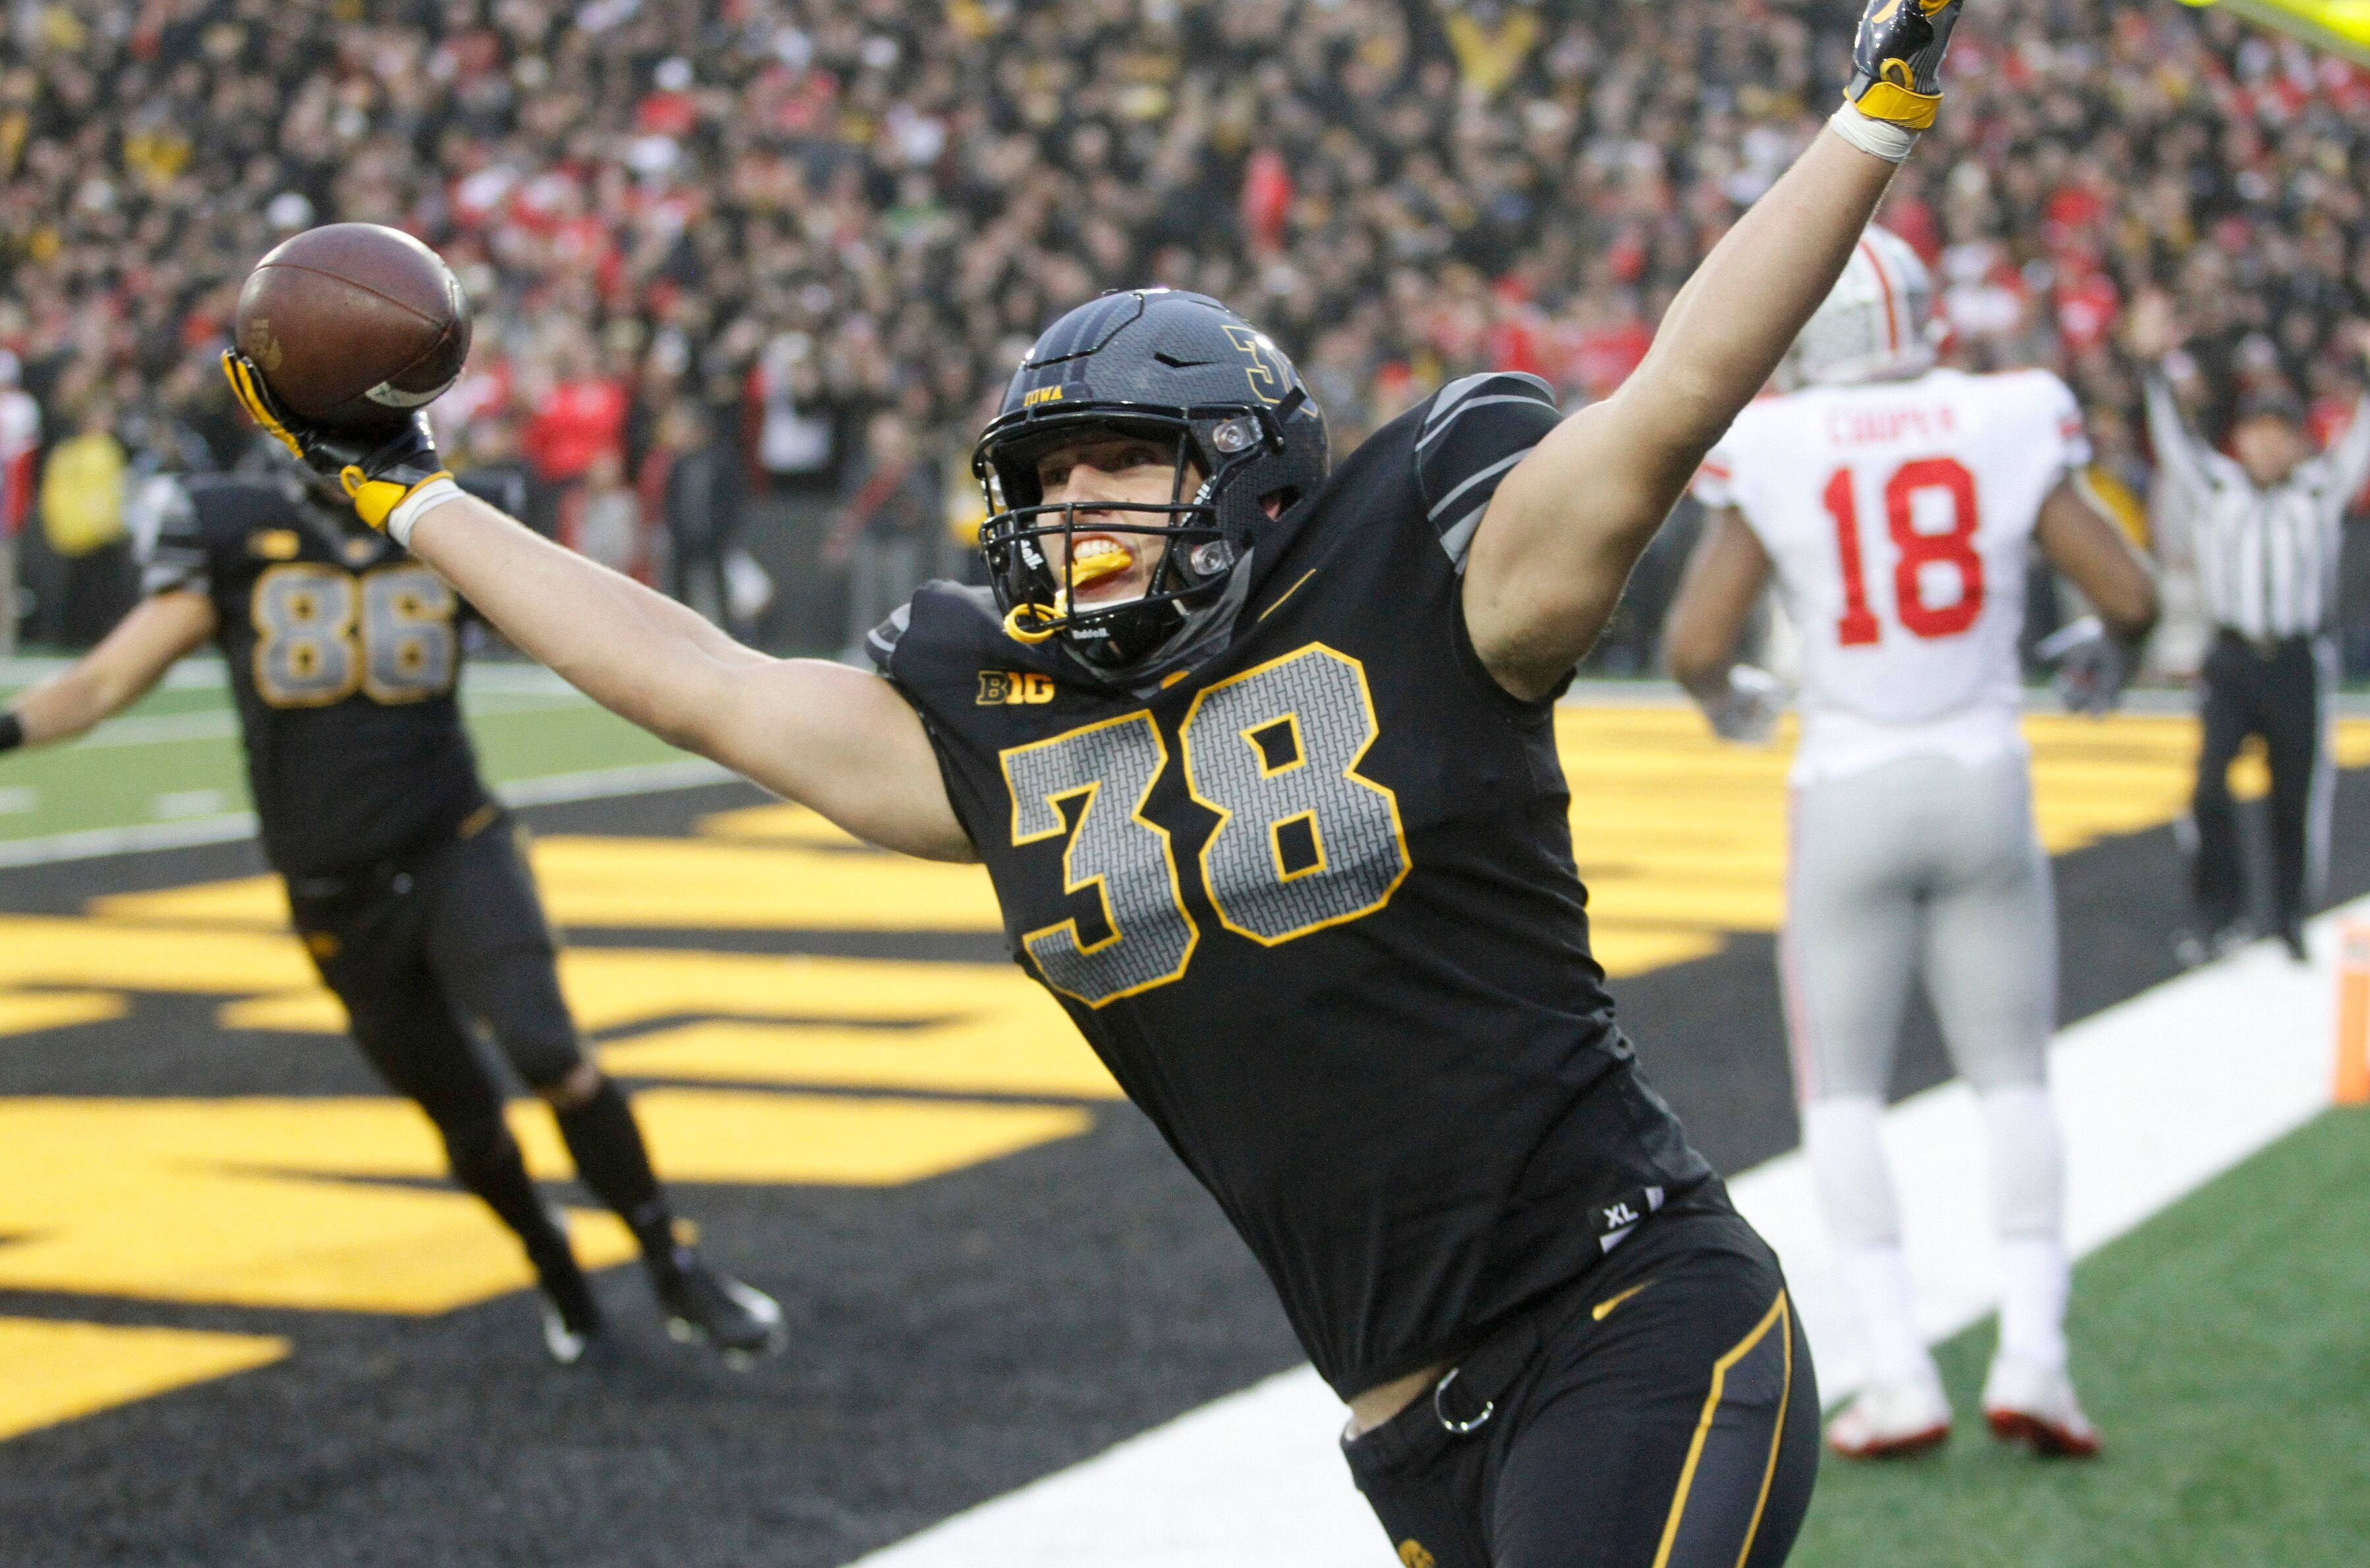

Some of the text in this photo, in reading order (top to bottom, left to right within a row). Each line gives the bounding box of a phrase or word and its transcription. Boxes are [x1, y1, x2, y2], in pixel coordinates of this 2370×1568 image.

[1023, 385, 1063, 407] IOWA
[1822, 456, 1985, 648] 18
[251, 563, 457, 708] 86
[999, 641, 1411, 1009] 38
[1603, 1202, 1639, 1229] XL
